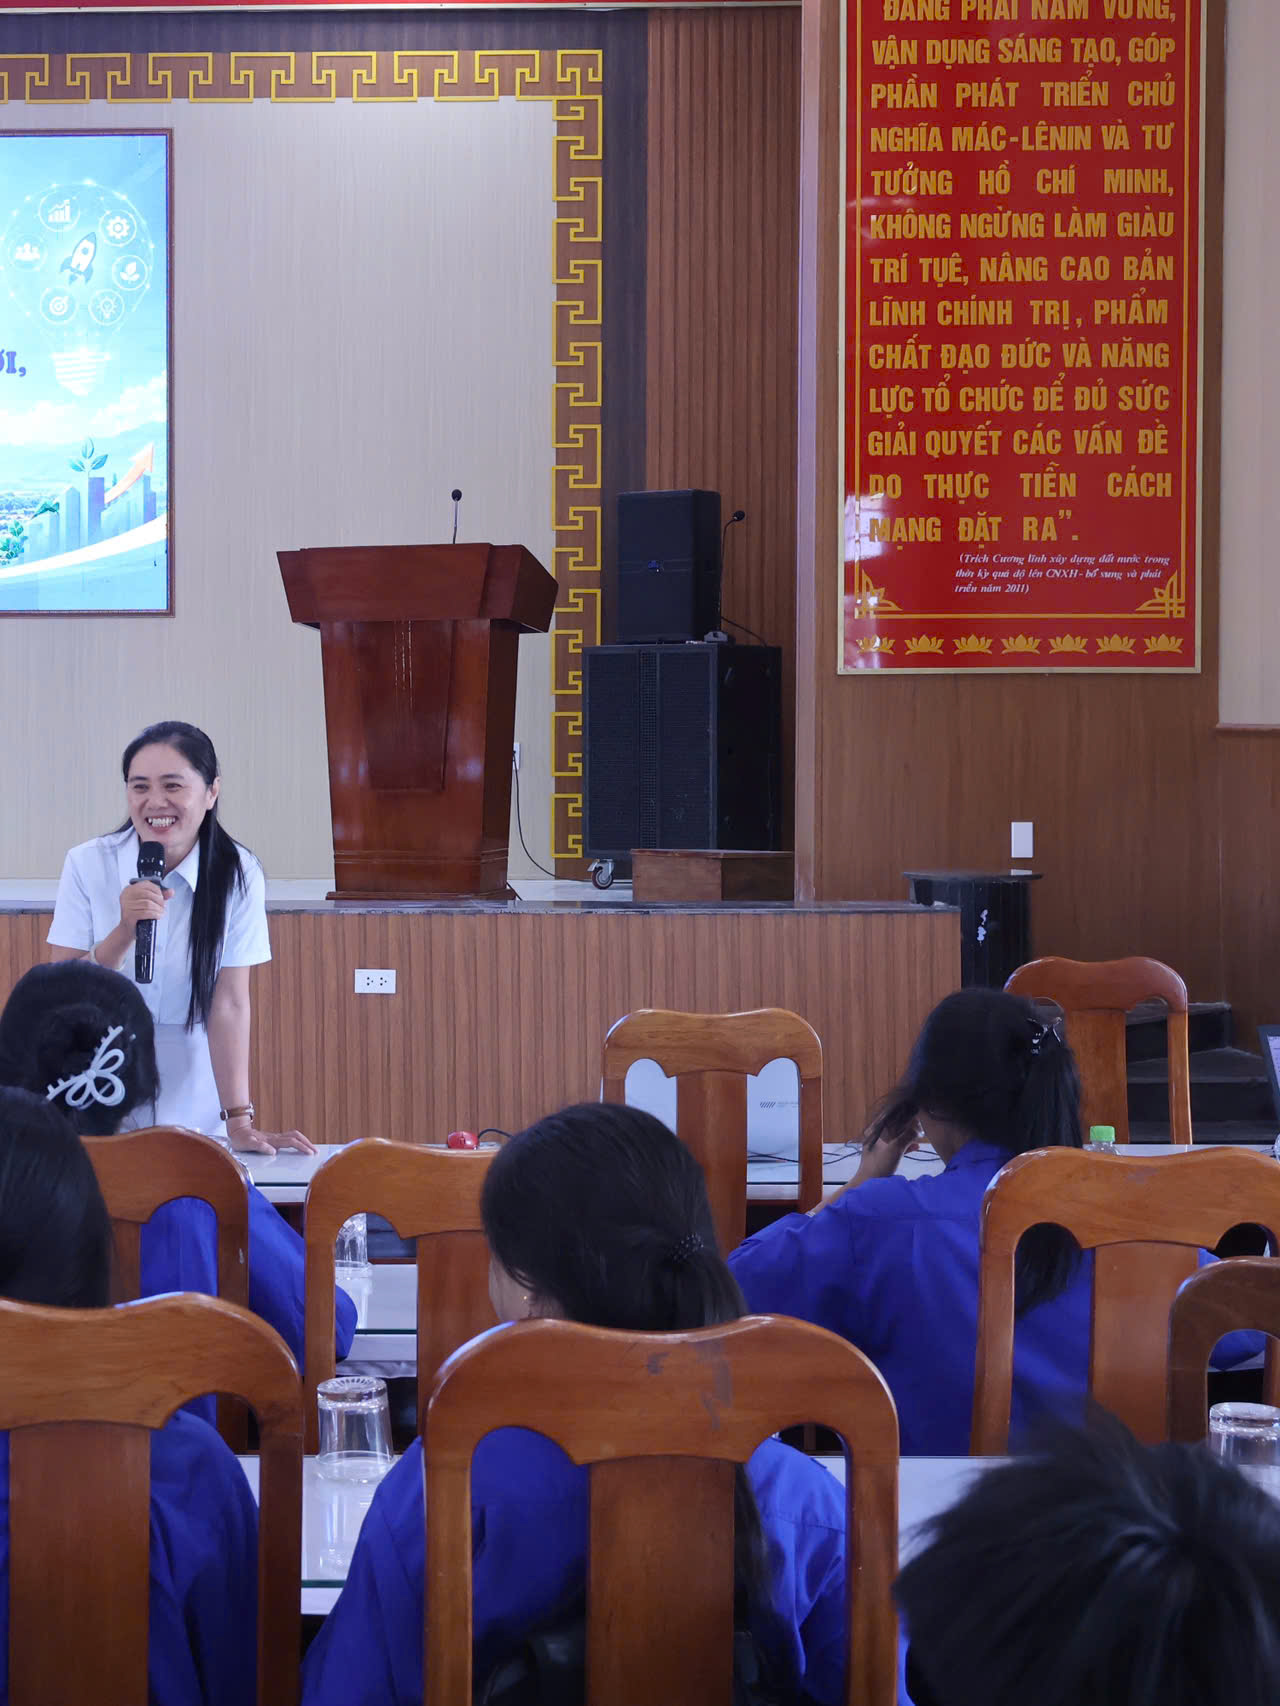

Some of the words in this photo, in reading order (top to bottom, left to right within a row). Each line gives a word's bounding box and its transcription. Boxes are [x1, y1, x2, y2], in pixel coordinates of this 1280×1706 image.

[872, 35, 917, 69] VẬN
[927, 39, 990, 69] DỤNG
[998, 33, 1061, 63] SÁNG
[1071, 38, 1121, 67] TẠO,
[1129, 32, 1175, 62] GÓP
[871, 73, 937, 108] PHẦN
[956, 77, 1019, 107] PHÁT
[1041, 70, 1108, 106] TRIỂN
[1128, 73, 1175, 106] CHỦ
[871, 122, 943, 152] NGHĨA
[1101, 119, 1129, 150] VÀ
[1142, 122, 1174, 149] TƯ
[871, 161, 952, 195] TƯỞNG
[979, 160, 1010, 194] HỒ
[1037, 165, 1075, 194] CHÍ
[1104, 169, 1173, 196] MINH,
[870, 208, 951, 240] KHÔNG
[961, 206, 1044, 238] NGỪNG
[1055, 206, 1106, 237] LÀM
[1118, 206, 1174, 237] GIÀU
[870, 253, 908, 283] TRÍ
[980, 252, 1048, 281] NÂNG
[1061, 256, 1109, 281] CAO
[1124, 248, 1173, 280] BẢN
[870, 296, 925, 326] LĨNH
[938, 295, 1012, 325] CHÍNH
[1095, 287, 1168, 324] PHẨM
[869, 334, 931, 369] CHẤT
[941, 344, 989, 375] ĐẠO
[1001, 337, 1051, 368] ĐỨC
[1062, 337, 1092, 367] VÀ
[1102, 337, 1169, 368] NĂNG
[870, 385, 913, 418] LỰC
[922, 374, 950, 412] TỔ
[960, 379, 1023, 411] CHỨC
[1033, 372, 1065, 411] ĐỂ
[1074, 378, 1107, 411] ĐỦ
[1118, 379, 1169, 411] SỨC
[868, 421, 916, 456] GIẢI
[926, 421, 1002, 458] QUYẾT
[1013, 423, 1061, 454] CÁC
[1074, 421, 1122, 454] VẤN
[1138, 419, 1168, 454] ĐỀ
[869, 474, 902, 500] DO
[924, 471, 989, 504] THỰC
[1020, 461, 1076, 497] TIỄN
[1107, 465, 1171, 497] CÁCH
[869, 517, 942, 551] MẠNG
[958, 512, 1002, 548] ĐẶT
